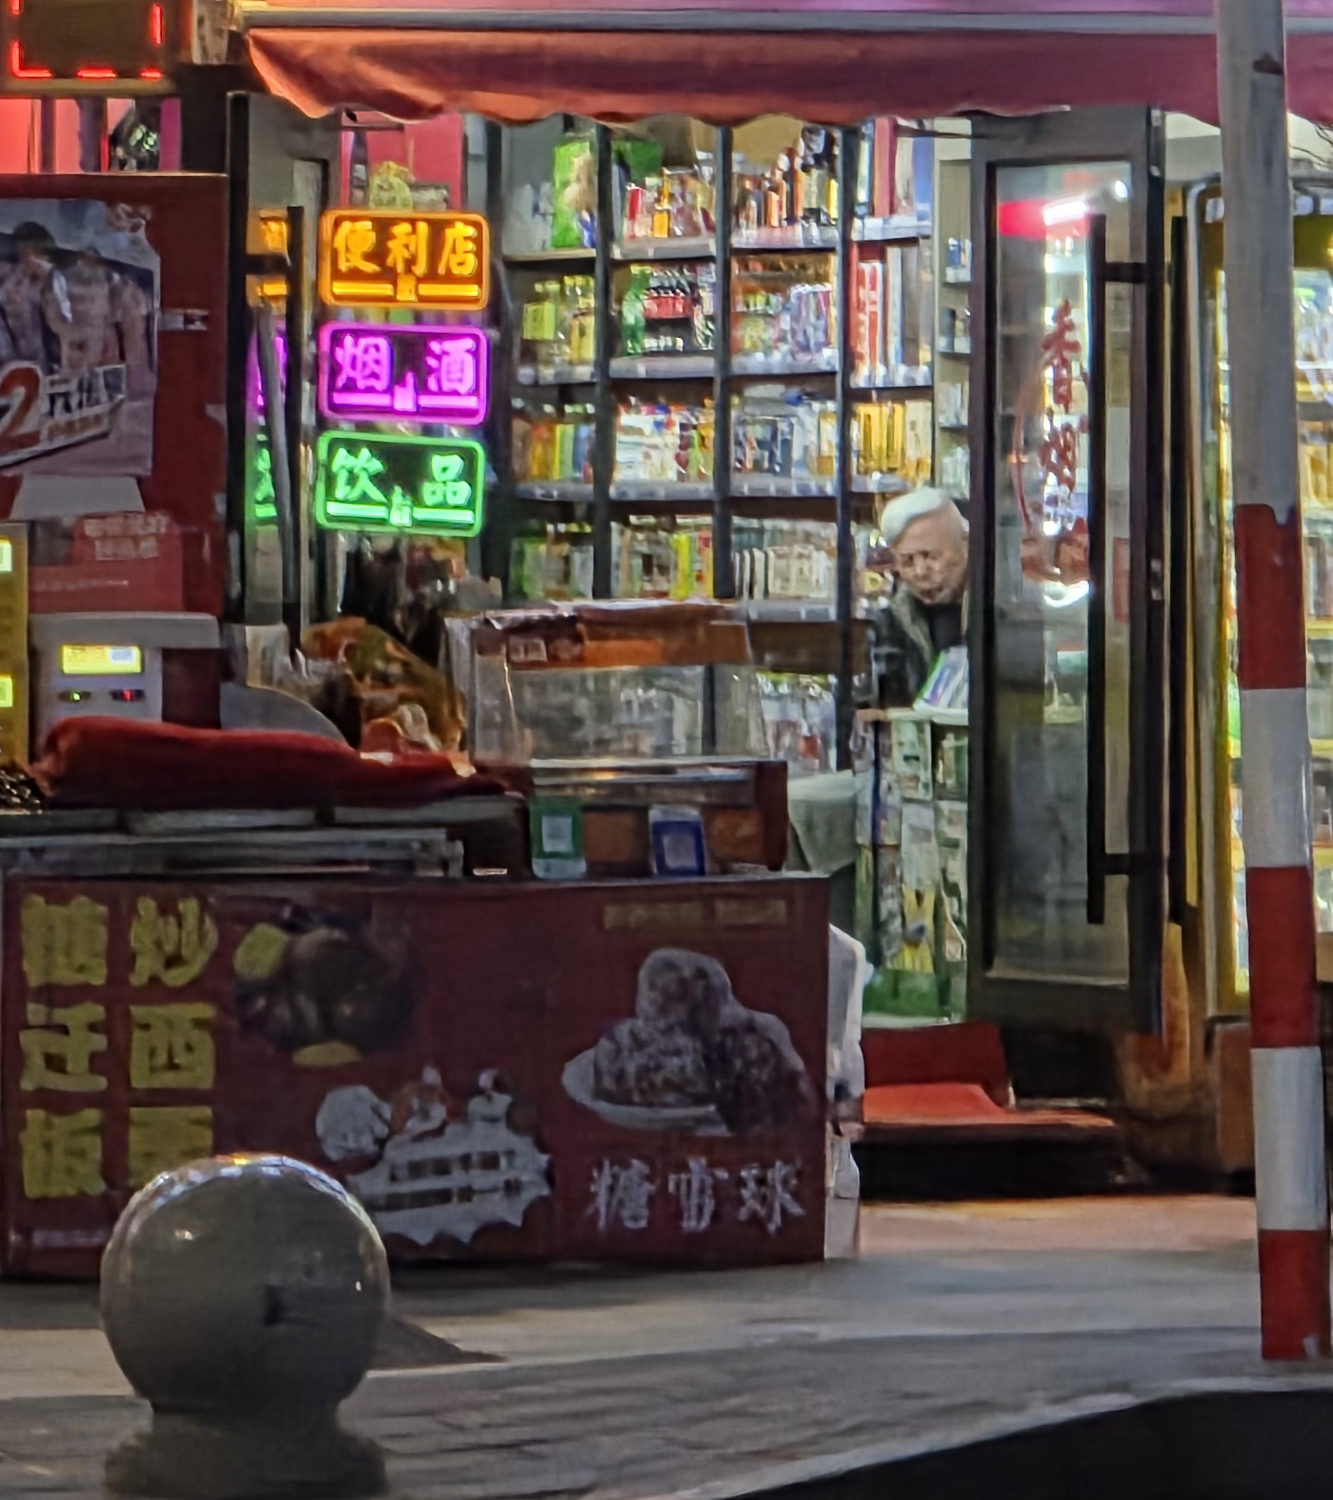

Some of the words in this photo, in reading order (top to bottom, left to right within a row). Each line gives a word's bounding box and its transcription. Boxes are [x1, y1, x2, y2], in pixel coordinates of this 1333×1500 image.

[334, 220, 481, 278] 便利店
[334, 333, 478, 396] 烟酒
[331, 447, 473, 508] 饮品
